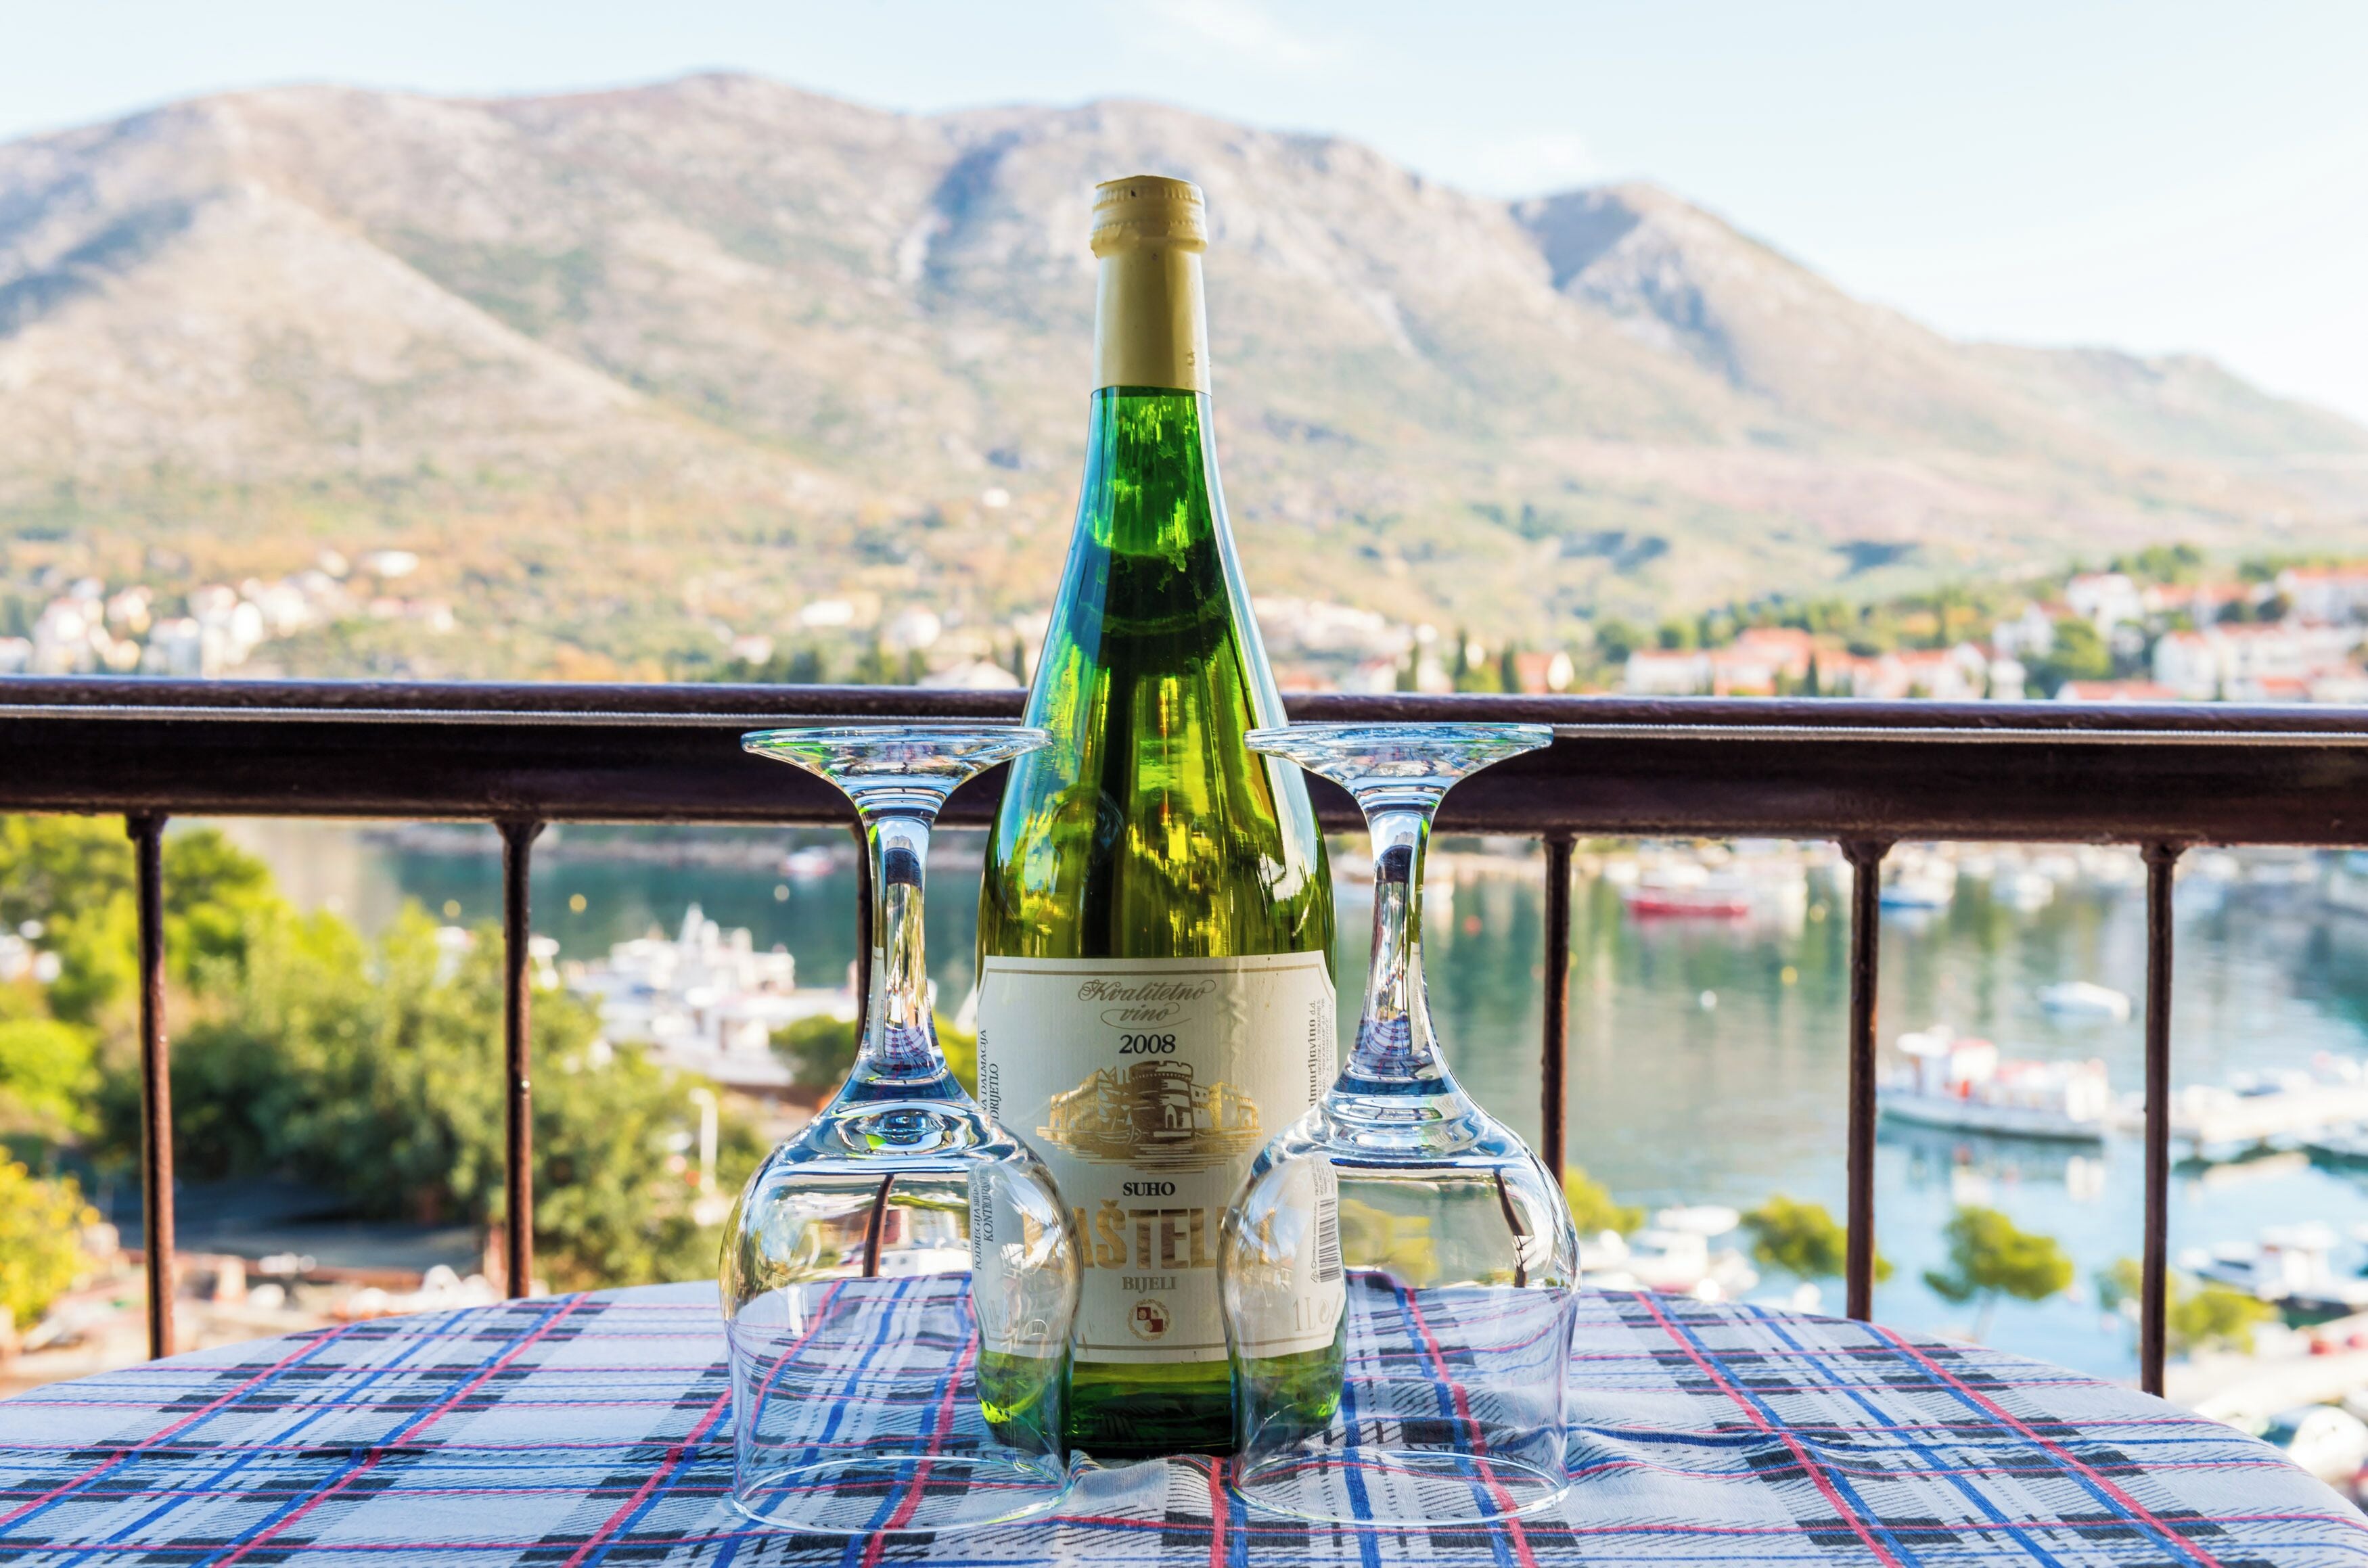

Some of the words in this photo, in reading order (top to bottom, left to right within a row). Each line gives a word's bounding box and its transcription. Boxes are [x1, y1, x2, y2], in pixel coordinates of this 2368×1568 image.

[1078, 979, 1216, 1001] Kvalitetno
[1101, 1001, 1181, 1021] vino
[1118, 1034, 1177, 1054] 2008
[980, 1029, 988, 1094] DALMACIJA
[989, 1063, 1001, 1120] DRIJETLO
[1122, 1182, 1176, 1197] SUHO
[974, 1208, 982, 1270] PODREGIJA
[1122, 1276, 1177, 1293] BIJELI
